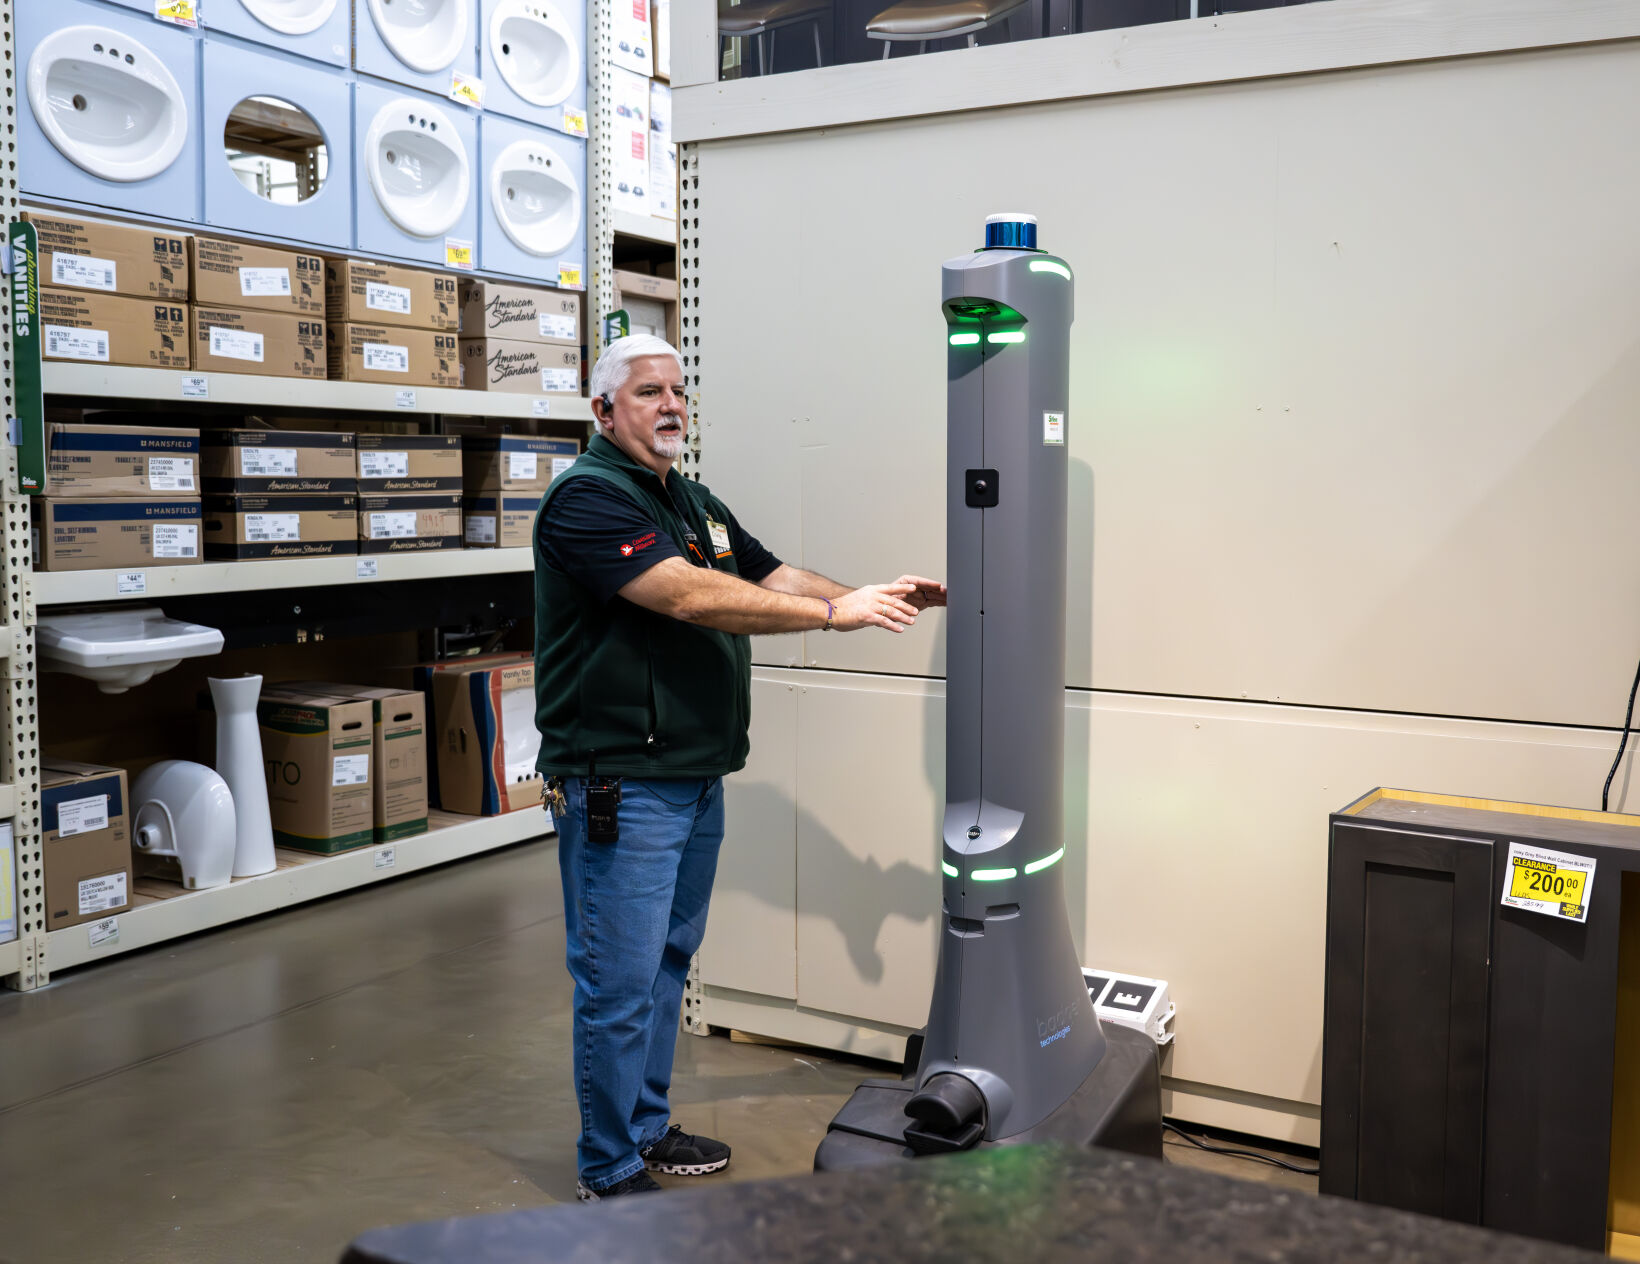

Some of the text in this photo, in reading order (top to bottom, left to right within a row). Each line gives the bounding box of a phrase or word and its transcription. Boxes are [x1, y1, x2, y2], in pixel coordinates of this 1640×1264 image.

[13, 234, 29, 336] VANITIES
[25, 248, 37, 315] plumbing
[485, 295, 534, 312] American
[489, 309, 537, 328] Standard
[487, 349, 536, 366] American
[491, 362, 539, 383] Standard
[148, 440, 192, 448] MANSFIELD
[267, 479, 330, 491] American Standard
[384, 479, 437, 489] American Standard
[154, 507, 197, 515] MANSFIELD
[270, 543, 333, 556] American Standard
[388, 539, 443, 551] American Standard
[1513, 857, 1556, 872] CLEARANCE
[1040, 1025, 1071, 1048] technologies
